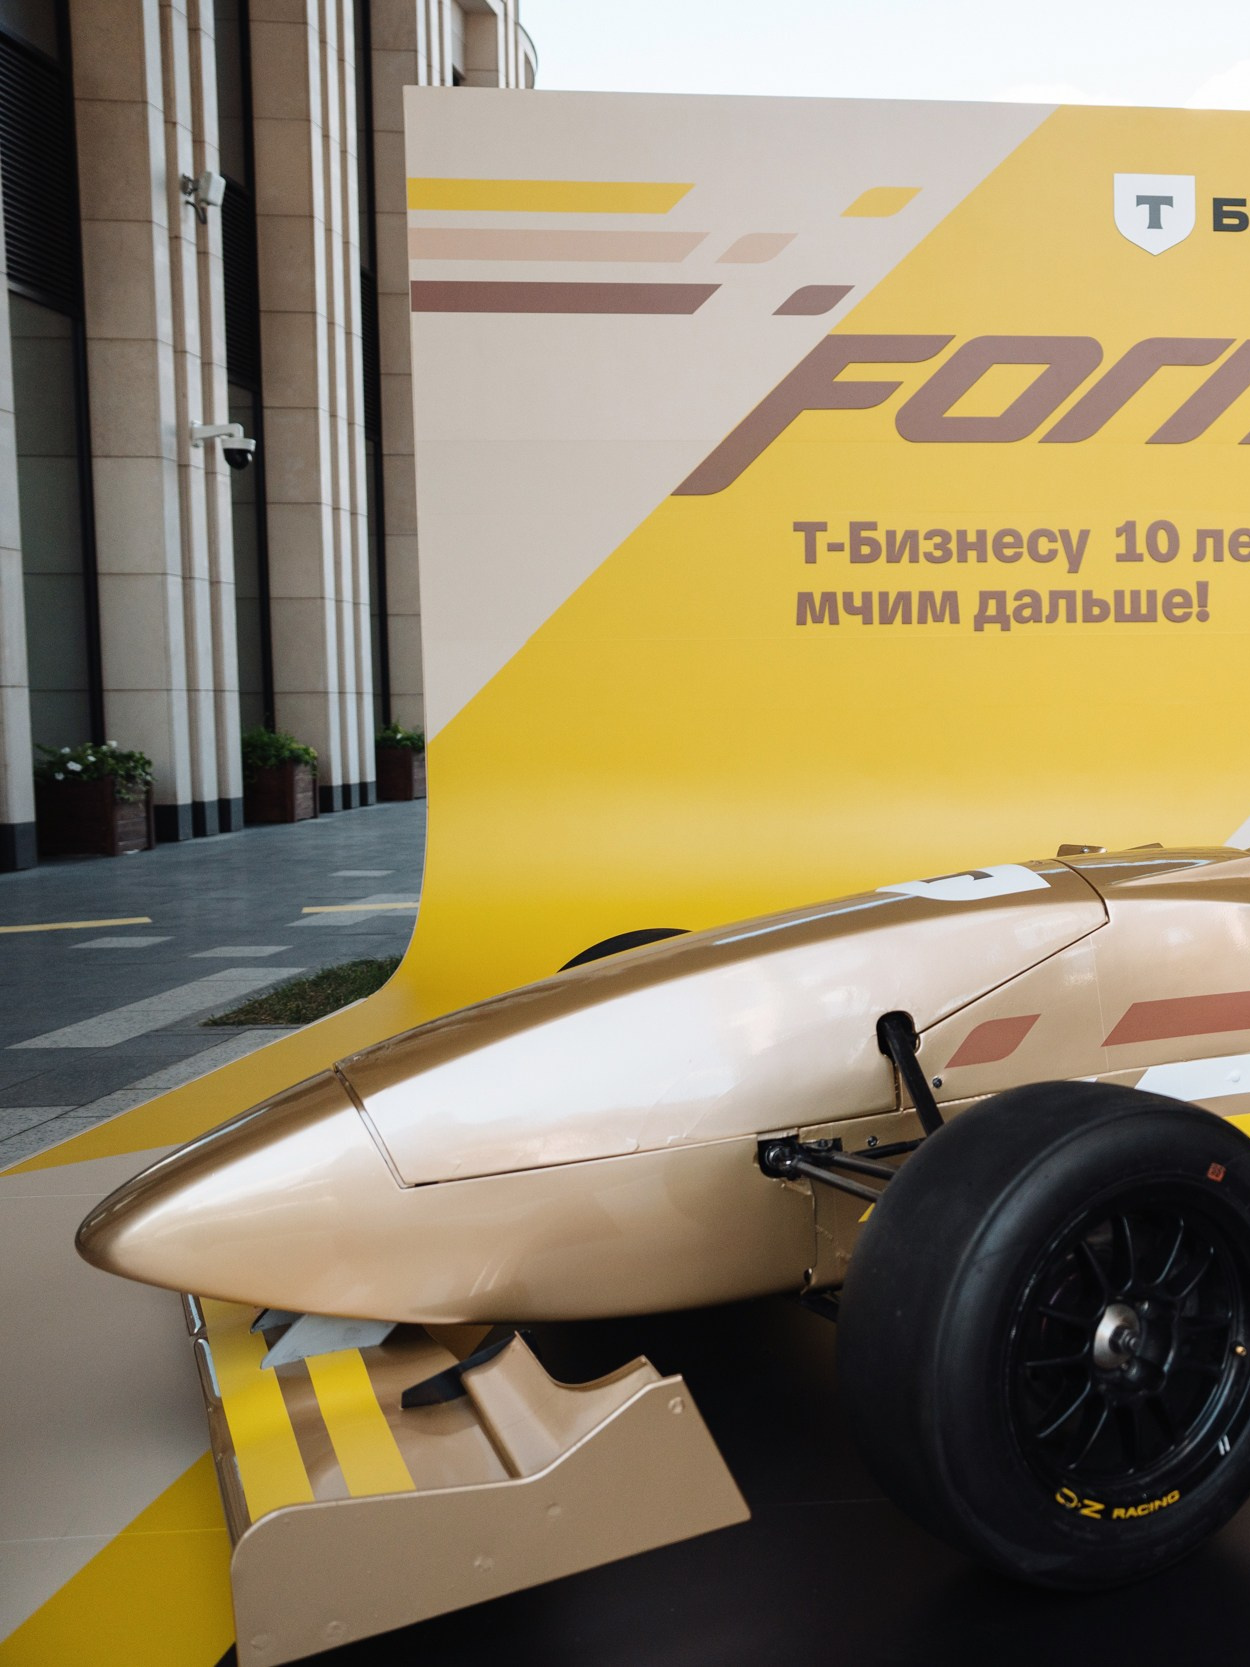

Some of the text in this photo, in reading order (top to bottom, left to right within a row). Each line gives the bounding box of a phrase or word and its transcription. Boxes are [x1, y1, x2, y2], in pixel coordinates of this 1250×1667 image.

[792, 521, 1092, 574] Т-Бизнесу
[1115, 519, 1180, 563] 10
[795, 580, 1211, 632] мчим дальше!
[1112, 1489, 1180, 1519] RACING
